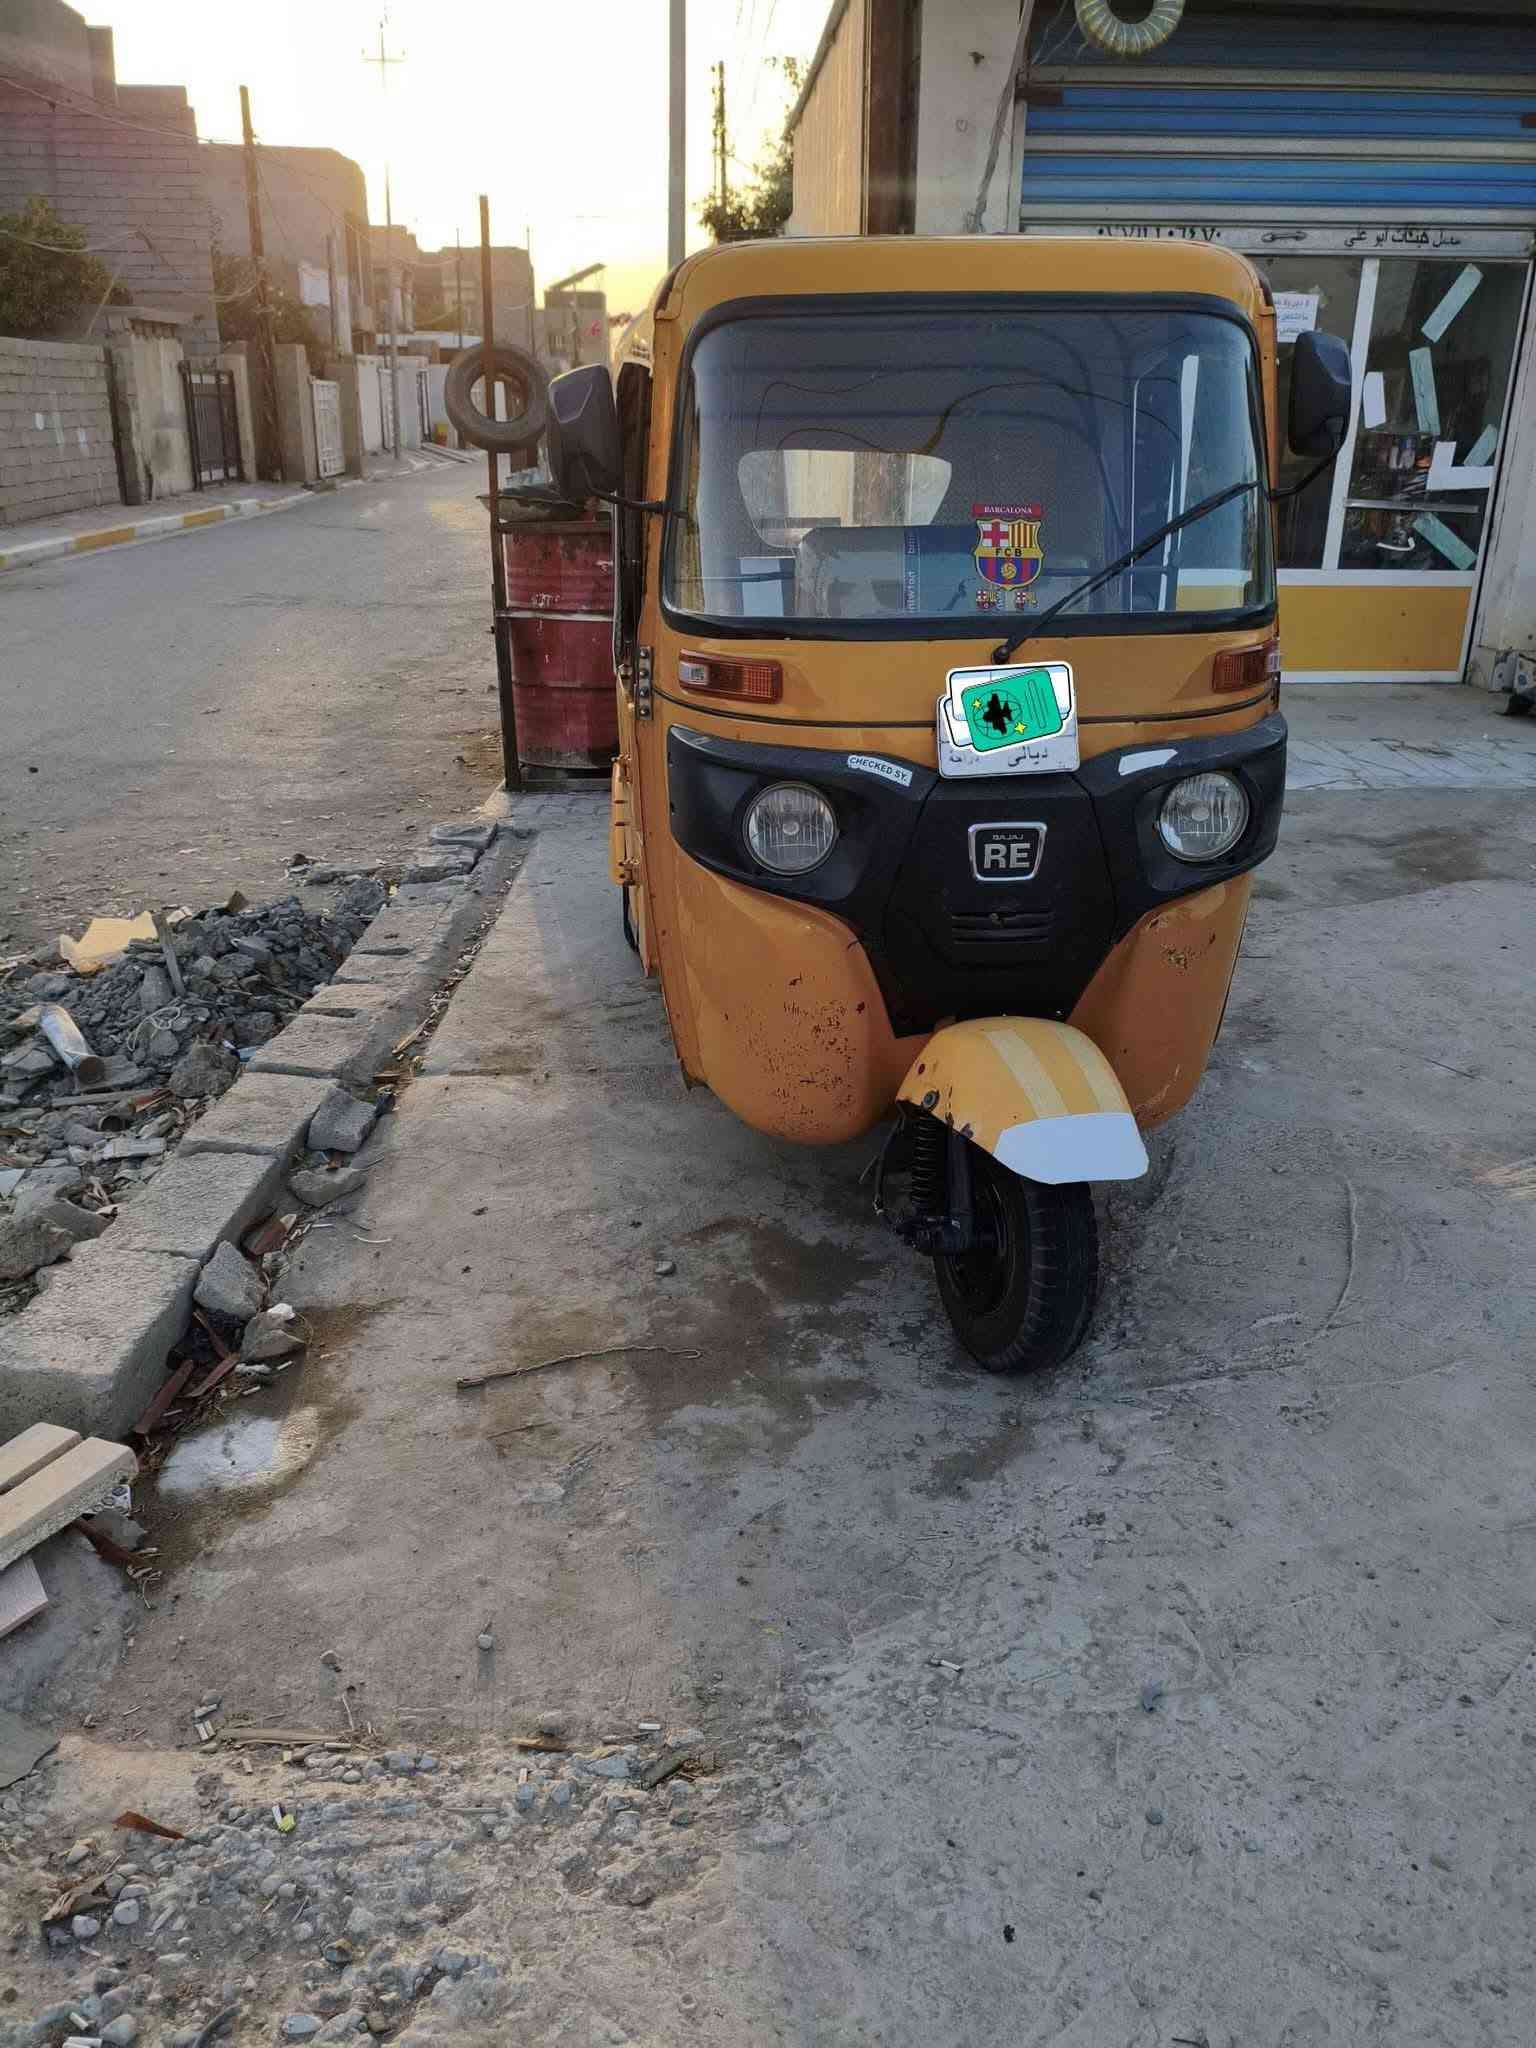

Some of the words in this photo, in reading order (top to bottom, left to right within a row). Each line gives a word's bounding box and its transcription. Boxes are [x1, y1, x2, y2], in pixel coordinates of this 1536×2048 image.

[984, 505, 1033, 514] BARCALONA
[995, 548, 1023, 558] FCB
[849, 756, 893, 775] CHECKED
[983, 842, 1031, 869] RE
